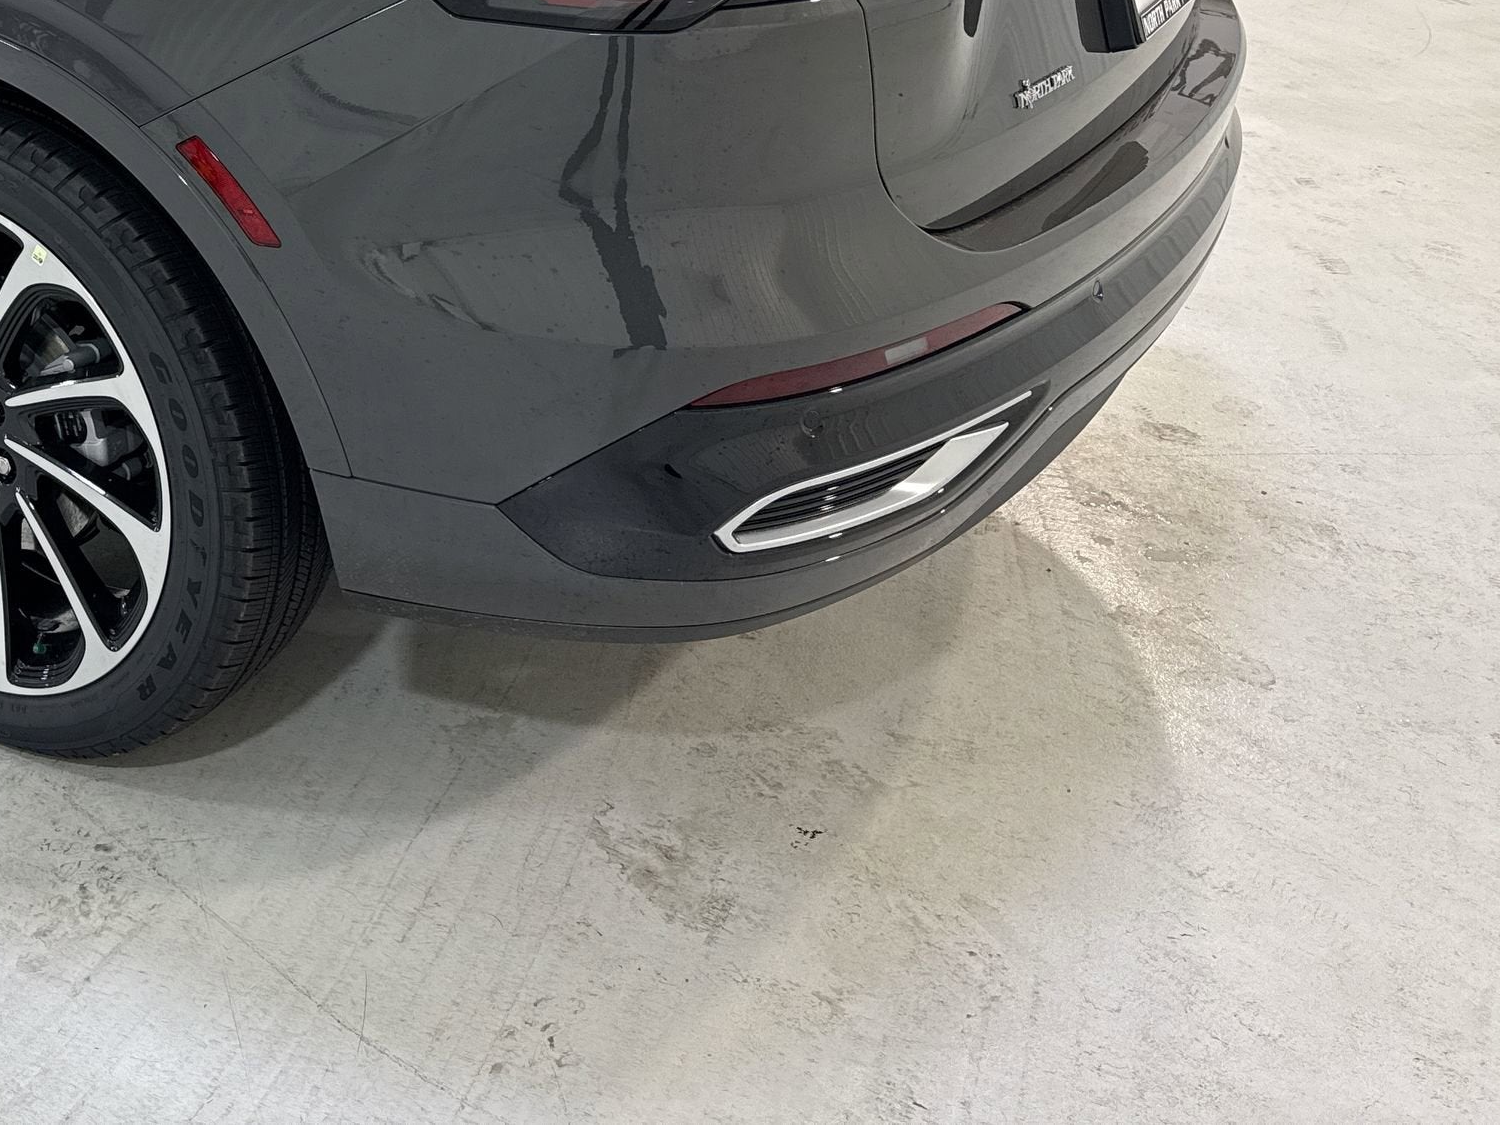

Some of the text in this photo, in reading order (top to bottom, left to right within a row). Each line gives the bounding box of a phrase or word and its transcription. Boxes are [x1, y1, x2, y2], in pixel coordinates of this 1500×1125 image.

[1141, 2, 1166, 36] NORTH
[1051, 65, 1076, 90] PARK
[136, 351, 208, 702] GOODYEAR
